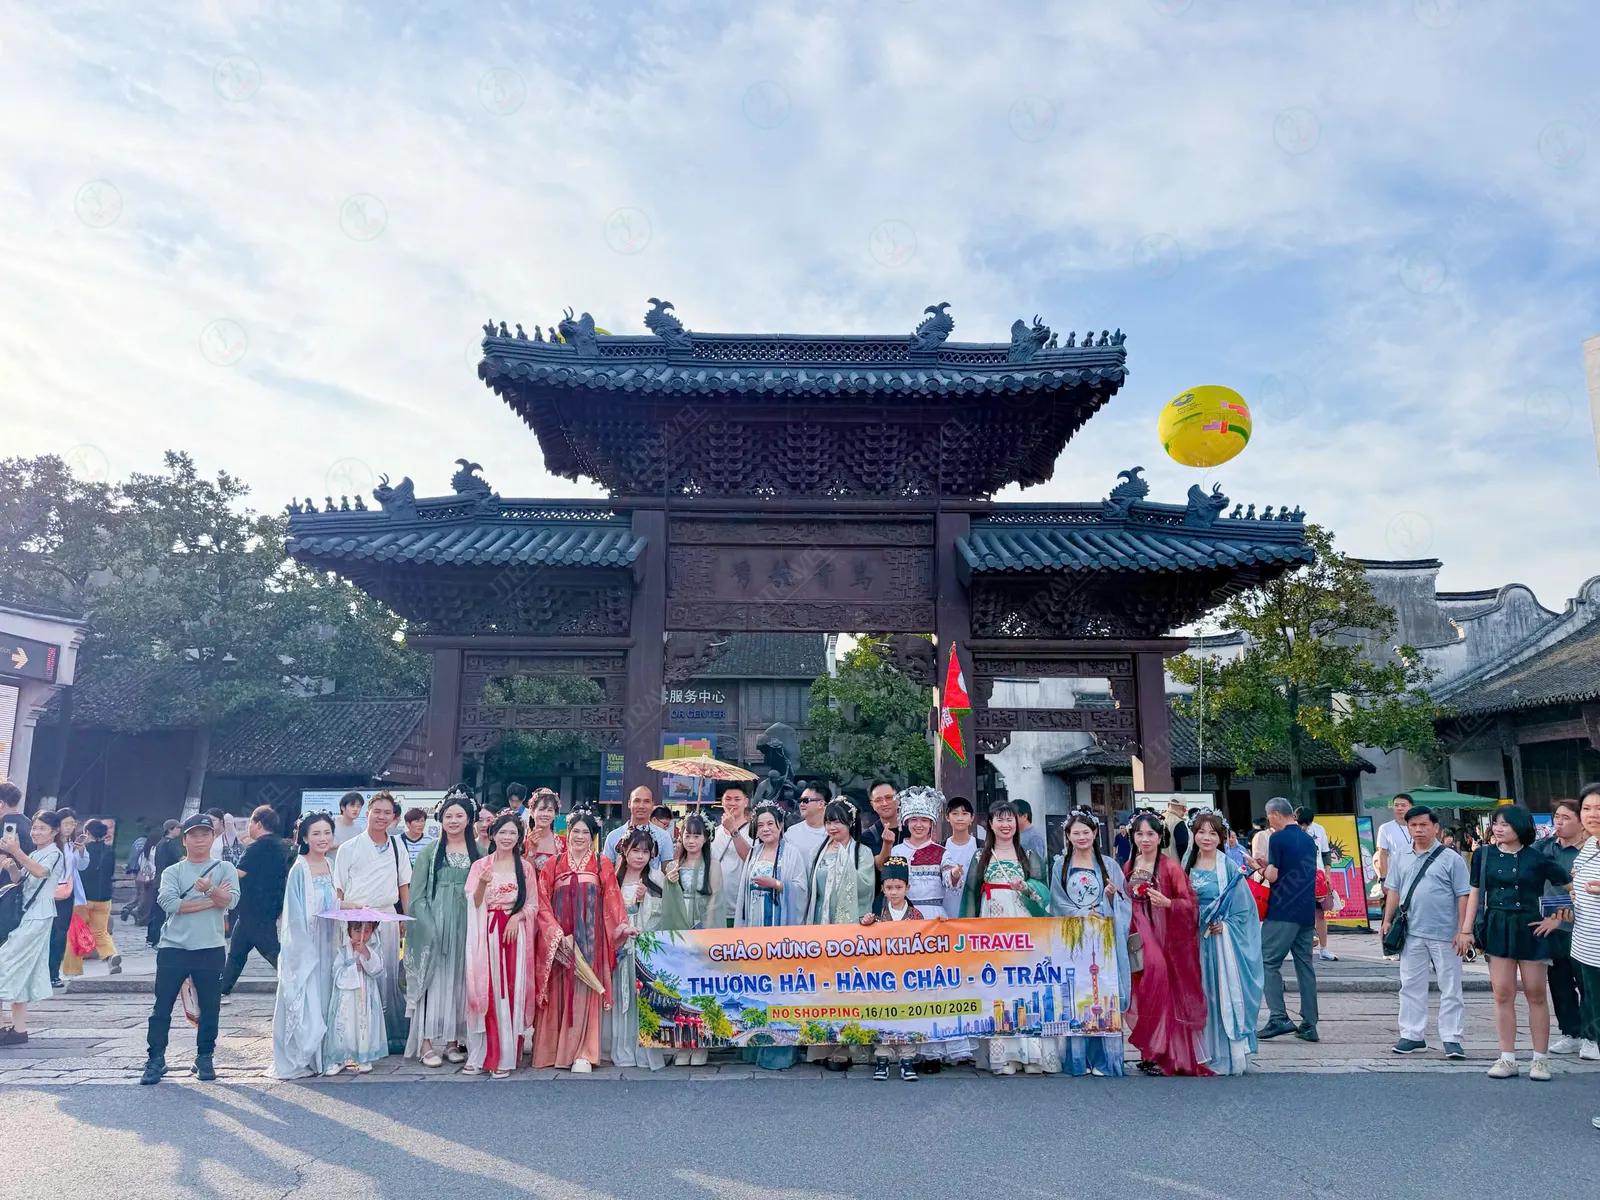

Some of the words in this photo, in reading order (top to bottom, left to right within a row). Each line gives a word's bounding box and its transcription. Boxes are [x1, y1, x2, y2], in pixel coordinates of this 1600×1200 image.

[709, 940, 762, 961] CHÀO
[766, 938, 821, 960] MỪNG
[826, 936, 882, 958] ĐOÀN
[886, 932, 949, 955] KHÁCH
[954, 934, 965, 951] J
[969, 934, 1034, 951] TRAVEL
[687, 975, 772, 995] THƯƠNG
[779, 968, 816, 993] HẢI
[836, 968, 896, 992] HÀNG
[903, 965, 960, 990] CHÂU
[981, 963, 996, 986] Ô
[1003, 961, 1062, 985] TRẤN
[772, 1008, 789, 1018] NO
[908, 1001, 977, 1017] 20/10/2026
